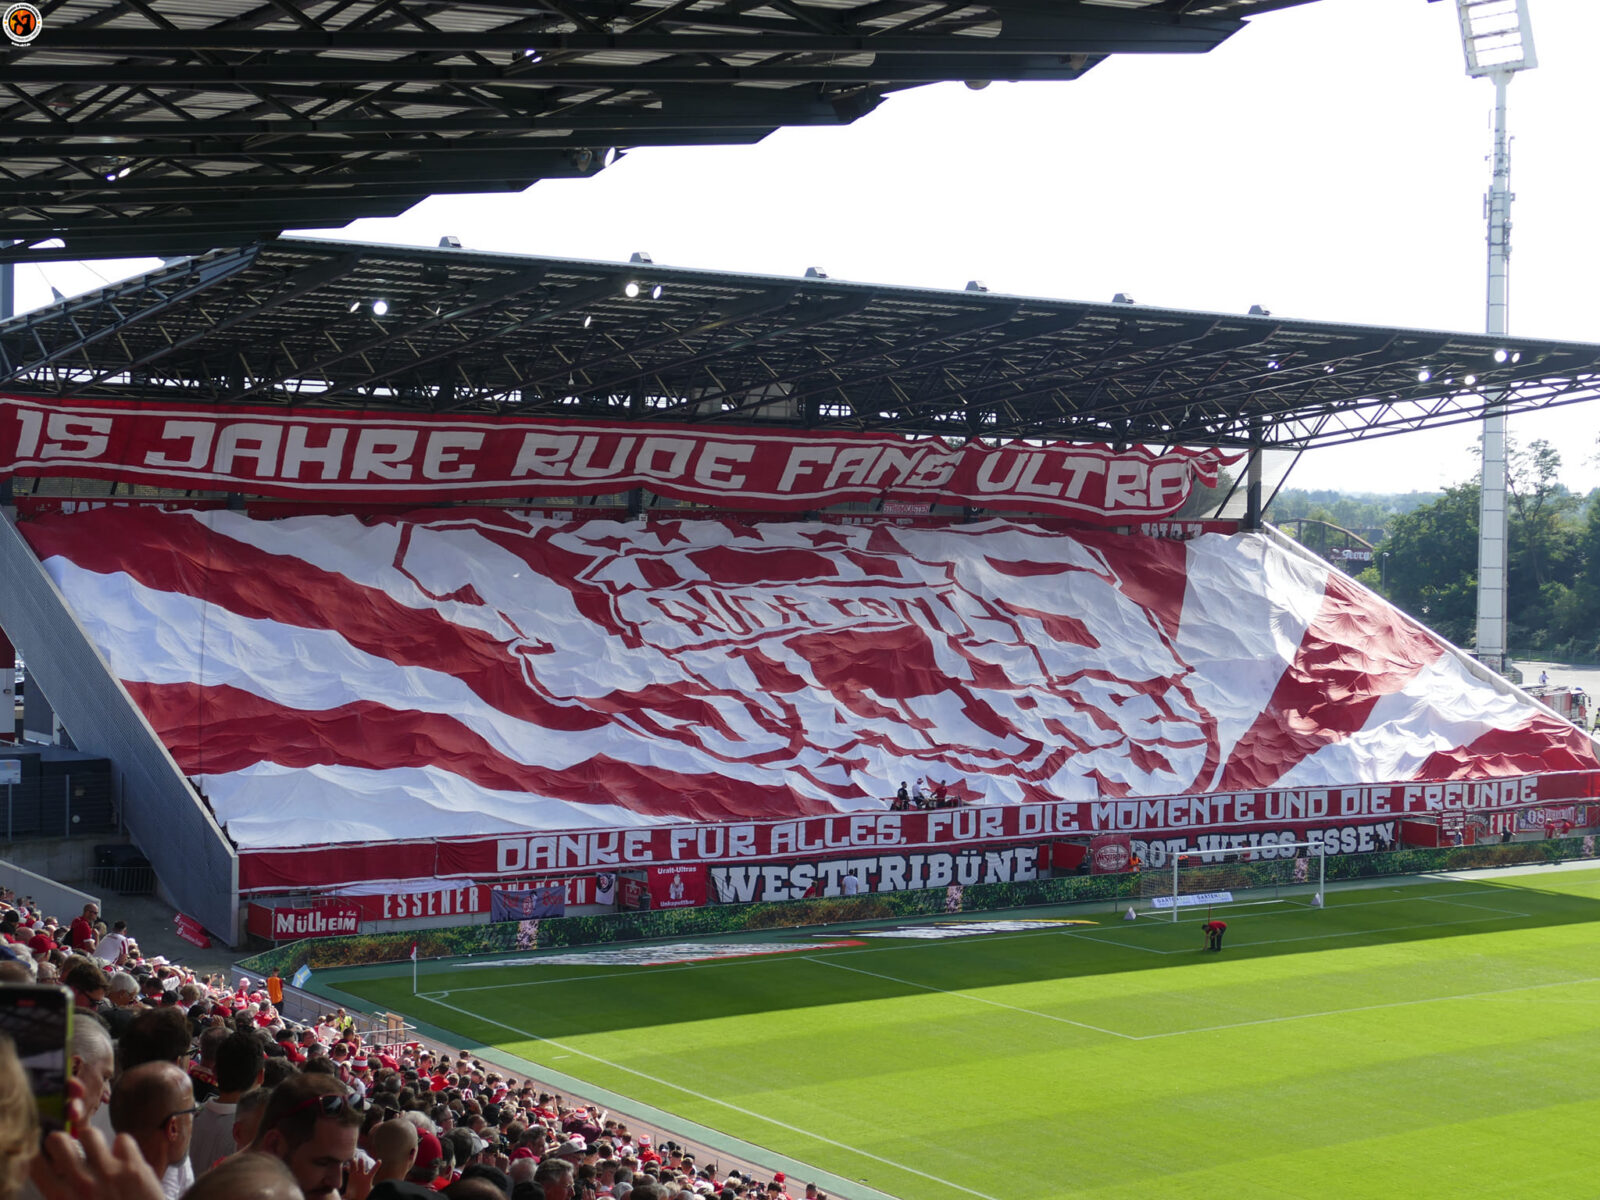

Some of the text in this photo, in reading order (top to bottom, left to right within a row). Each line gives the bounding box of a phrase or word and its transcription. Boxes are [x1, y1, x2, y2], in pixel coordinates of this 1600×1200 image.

[16, 408, 112, 460] 15
[144, 421, 484, 480] JAHRE
[510, 432, 757, 489] RUDE
[776, 446, 964, 492] FANS
[496, 777, 1539, 872] DANKE FÜR ALLES, FÜR DIE MOMENTE UND DIE FREUNDE
[1307, 821, 1396, 857] ESSEN
[384, 889, 480, 919] ESSENER
[710, 846, 1038, 904] WESTTRIBÜNE
